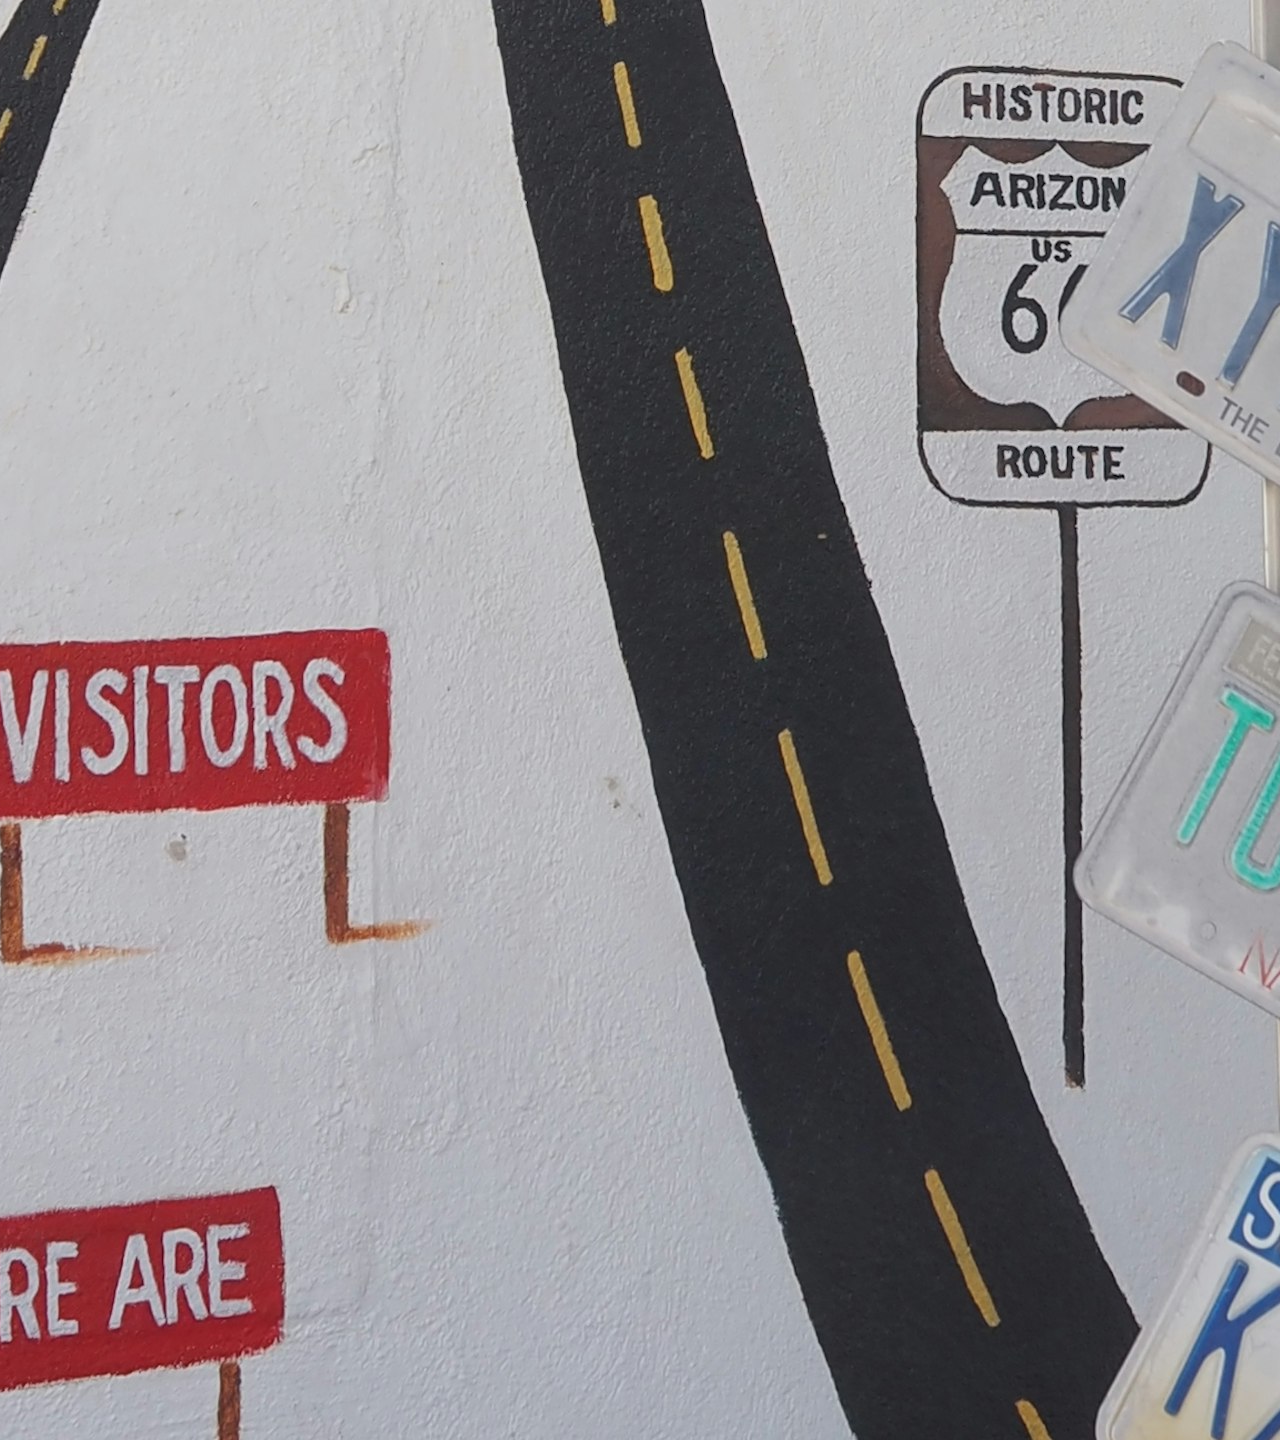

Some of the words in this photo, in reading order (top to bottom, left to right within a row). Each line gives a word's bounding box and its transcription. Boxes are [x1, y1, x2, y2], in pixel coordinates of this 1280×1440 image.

[963, 81, 1145, 125] HISTORIC
[1031, 238, 1073, 263] US
[1218, 396, 1268, 446] THE
[997, 444, 1126, 480] ROUTE
[109, 1222, 254, 1330] ARE
